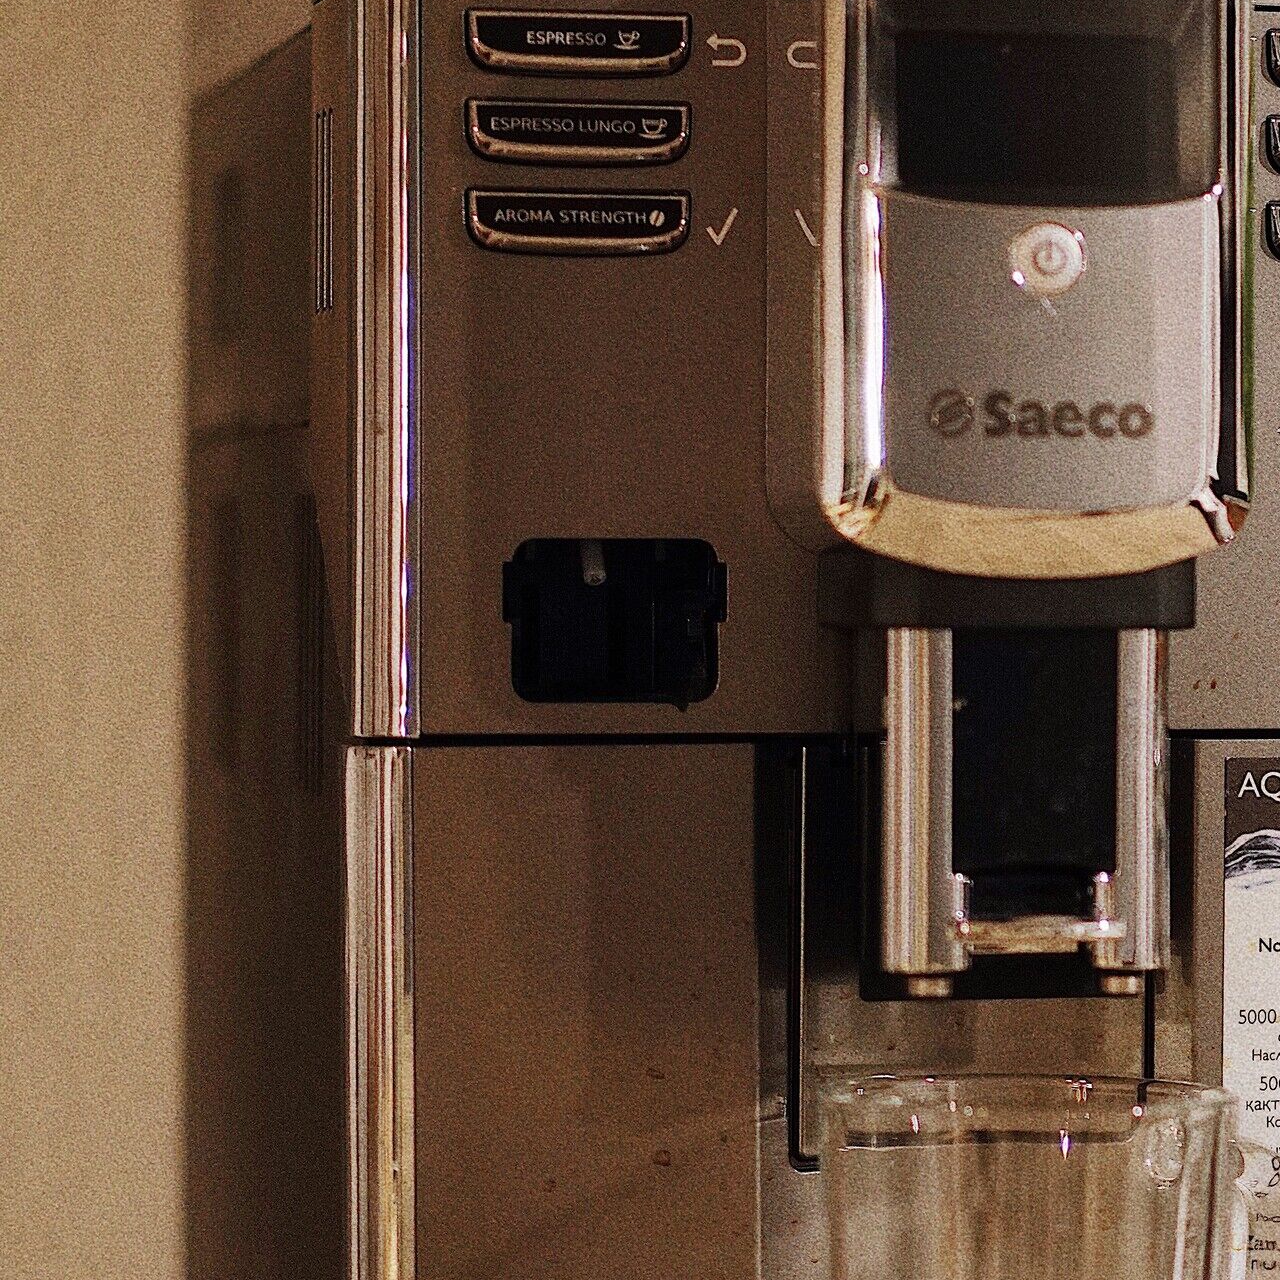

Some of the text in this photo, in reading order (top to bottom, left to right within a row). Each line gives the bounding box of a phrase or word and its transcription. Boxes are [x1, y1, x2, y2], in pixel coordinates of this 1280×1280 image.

[527, 31, 606, 46] ESPRESSO
[491, 116, 636, 134] ESPRESSO LUNGO
[495, 208, 646, 224] AROMA STRENGTH
[982, 389, 1157, 440] Saeco
[1239, 1009, 1276, 1024] 5000
